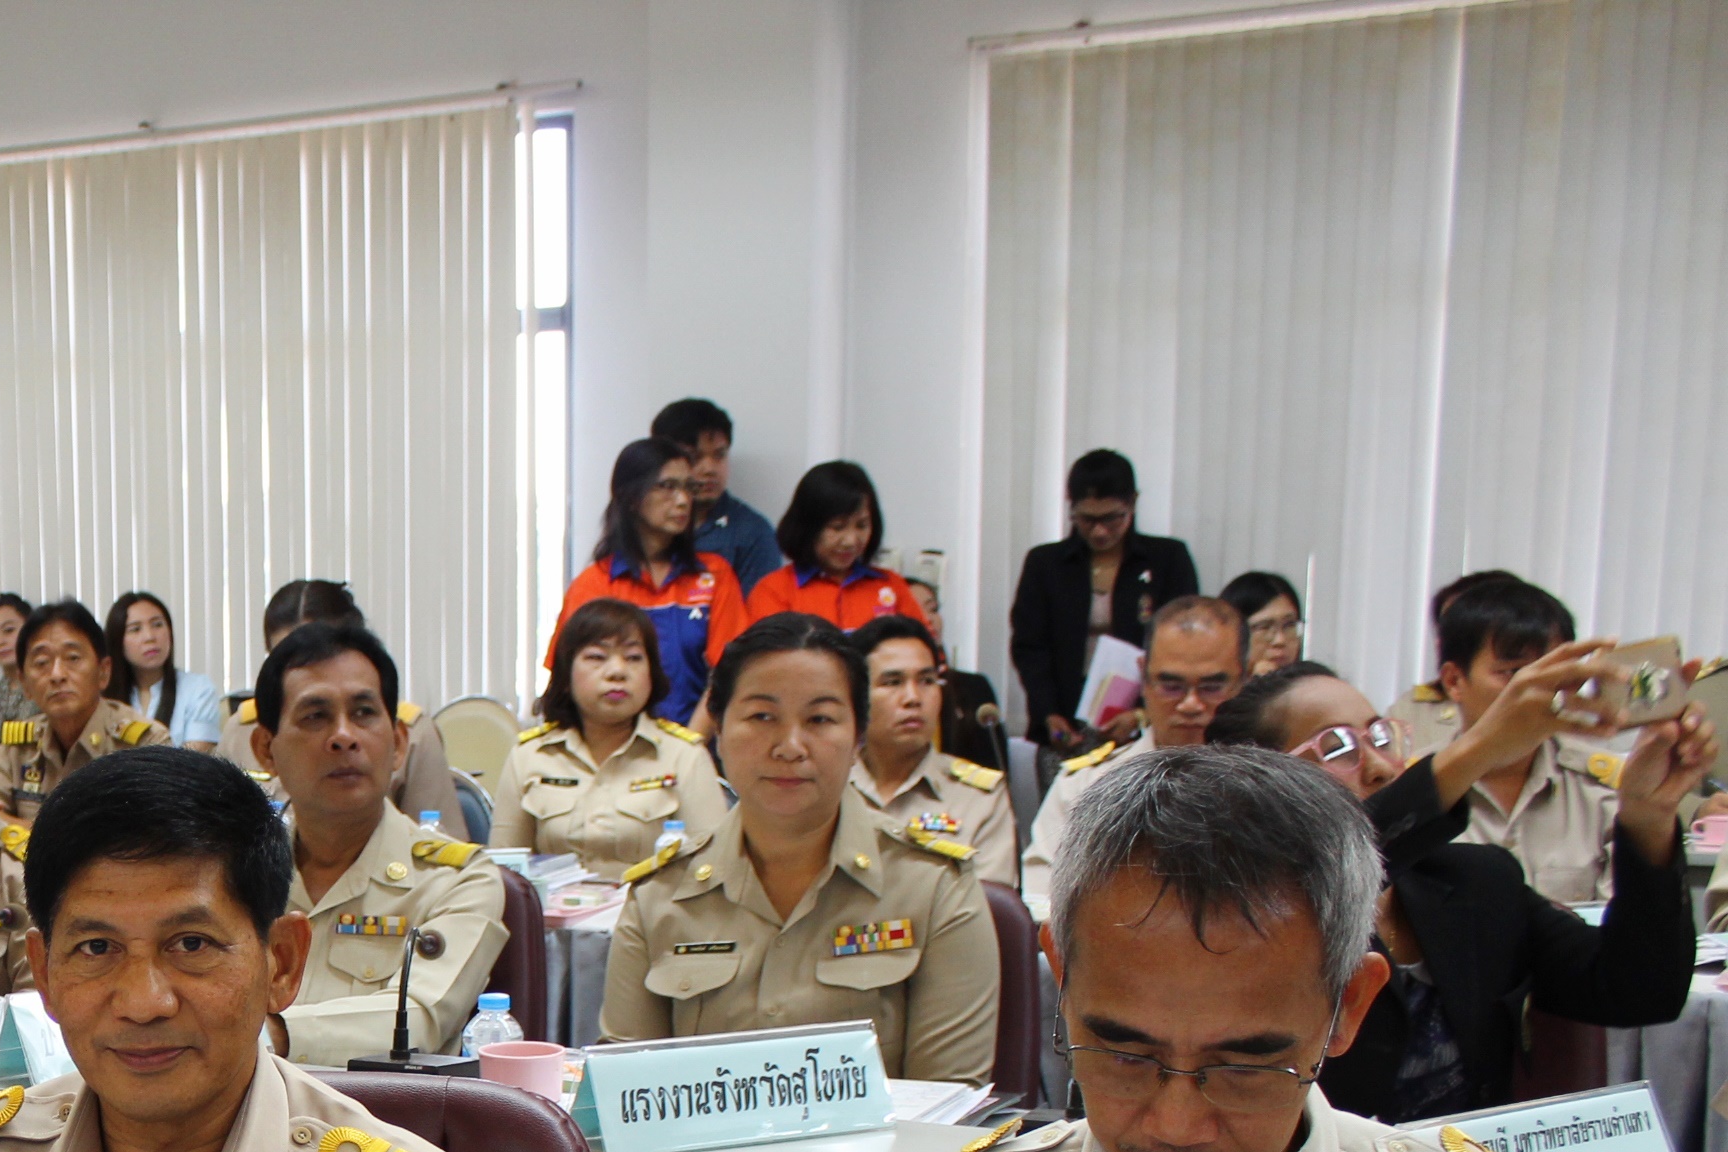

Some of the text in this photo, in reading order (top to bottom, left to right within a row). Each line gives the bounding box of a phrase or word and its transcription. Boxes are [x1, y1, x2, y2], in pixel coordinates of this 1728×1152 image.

[621, 1048, 867, 1123] แรงงานจังหวัดสุโขทัย
